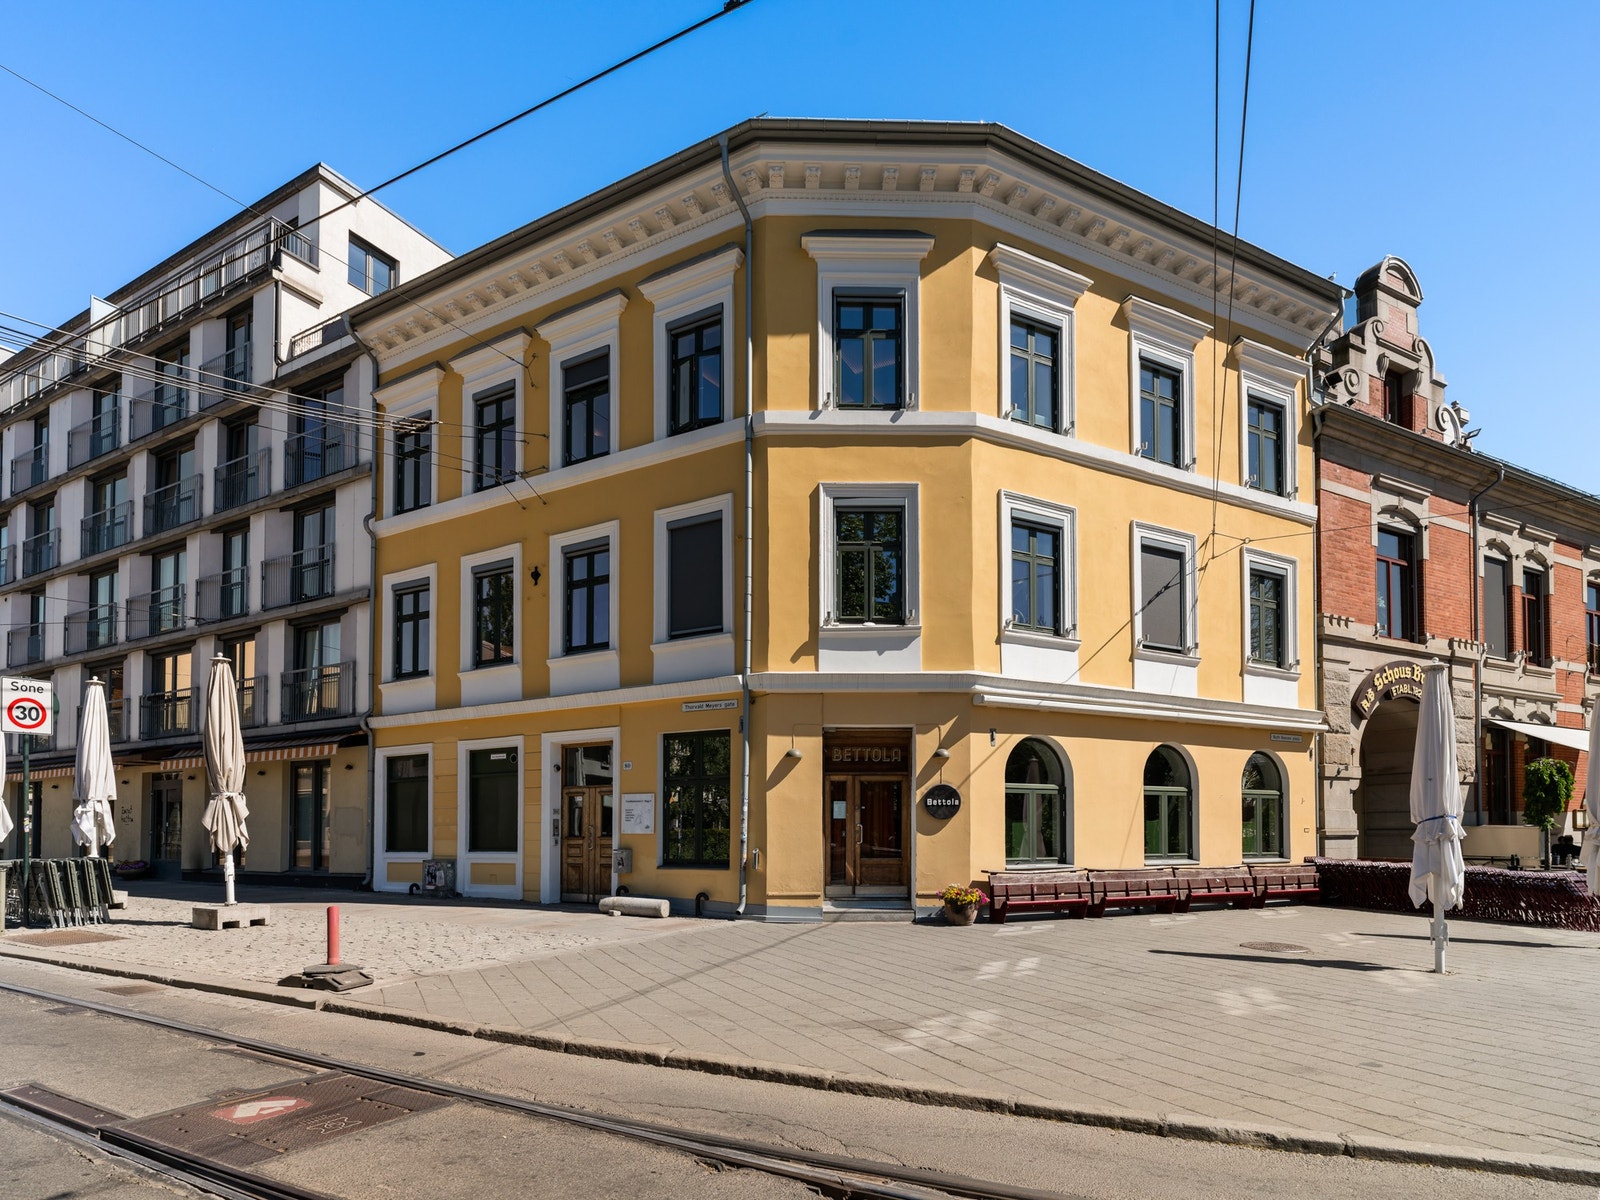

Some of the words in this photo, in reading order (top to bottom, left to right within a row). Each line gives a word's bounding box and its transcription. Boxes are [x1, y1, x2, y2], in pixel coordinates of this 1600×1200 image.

[1374, 666, 1412, 691] Schous
[10, 681, 44, 694] Sone
[15, 705, 40, 721] 30
[831, 746, 902, 762] BETTOLA
[926, 798, 959, 806] Bettola
